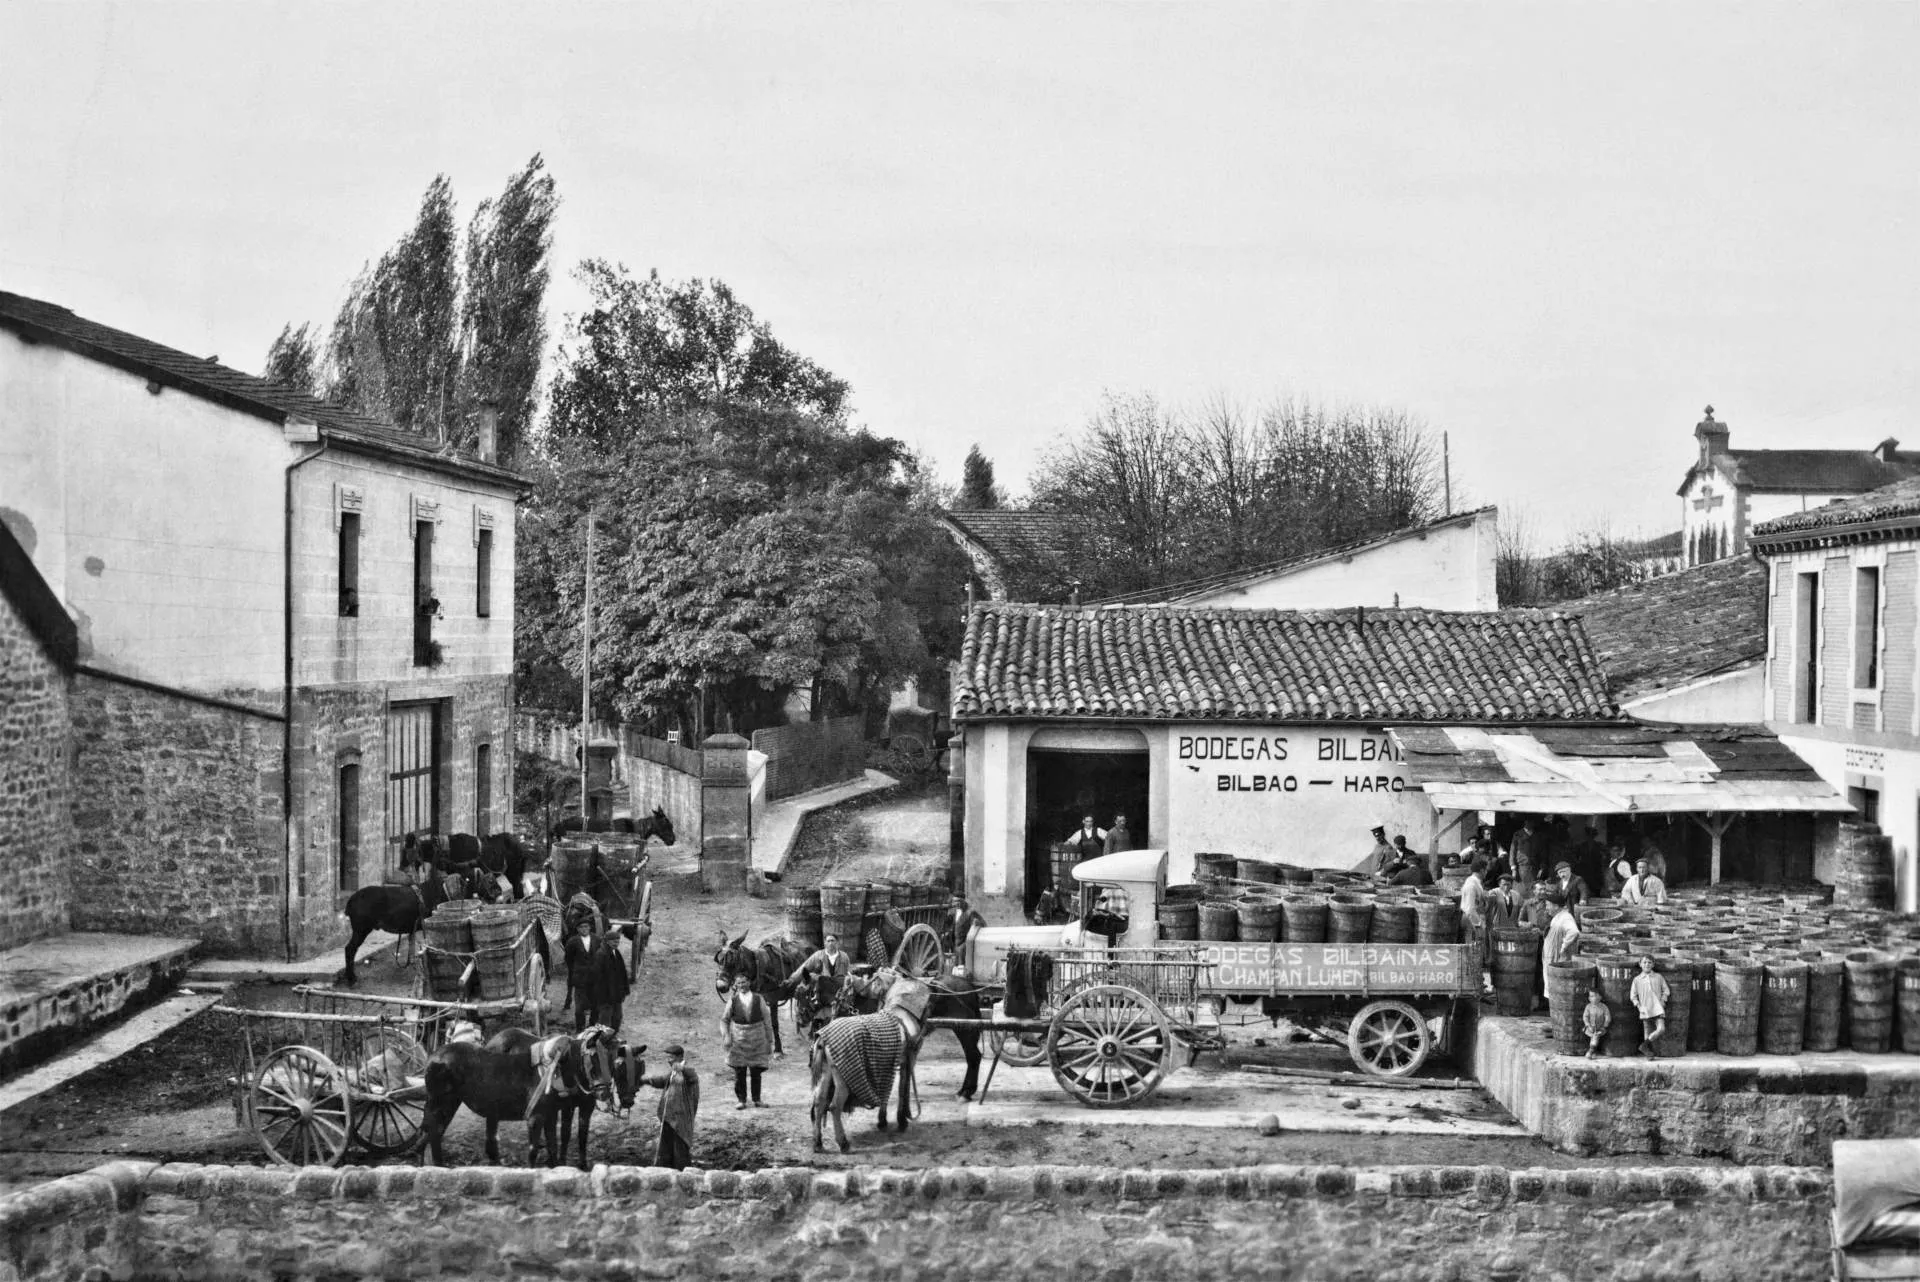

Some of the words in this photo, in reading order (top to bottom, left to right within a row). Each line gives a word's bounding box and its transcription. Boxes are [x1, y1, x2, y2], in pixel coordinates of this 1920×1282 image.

[1179, 736, 1288, 761] BODEGAS
[1318, 737, 1405, 762] BILBAI
[1217, 774, 1298, 792] BILBAO
[1344, 775, 1405, 793] HARO
[1322, 947, 1450, 966] BILBAINAS
